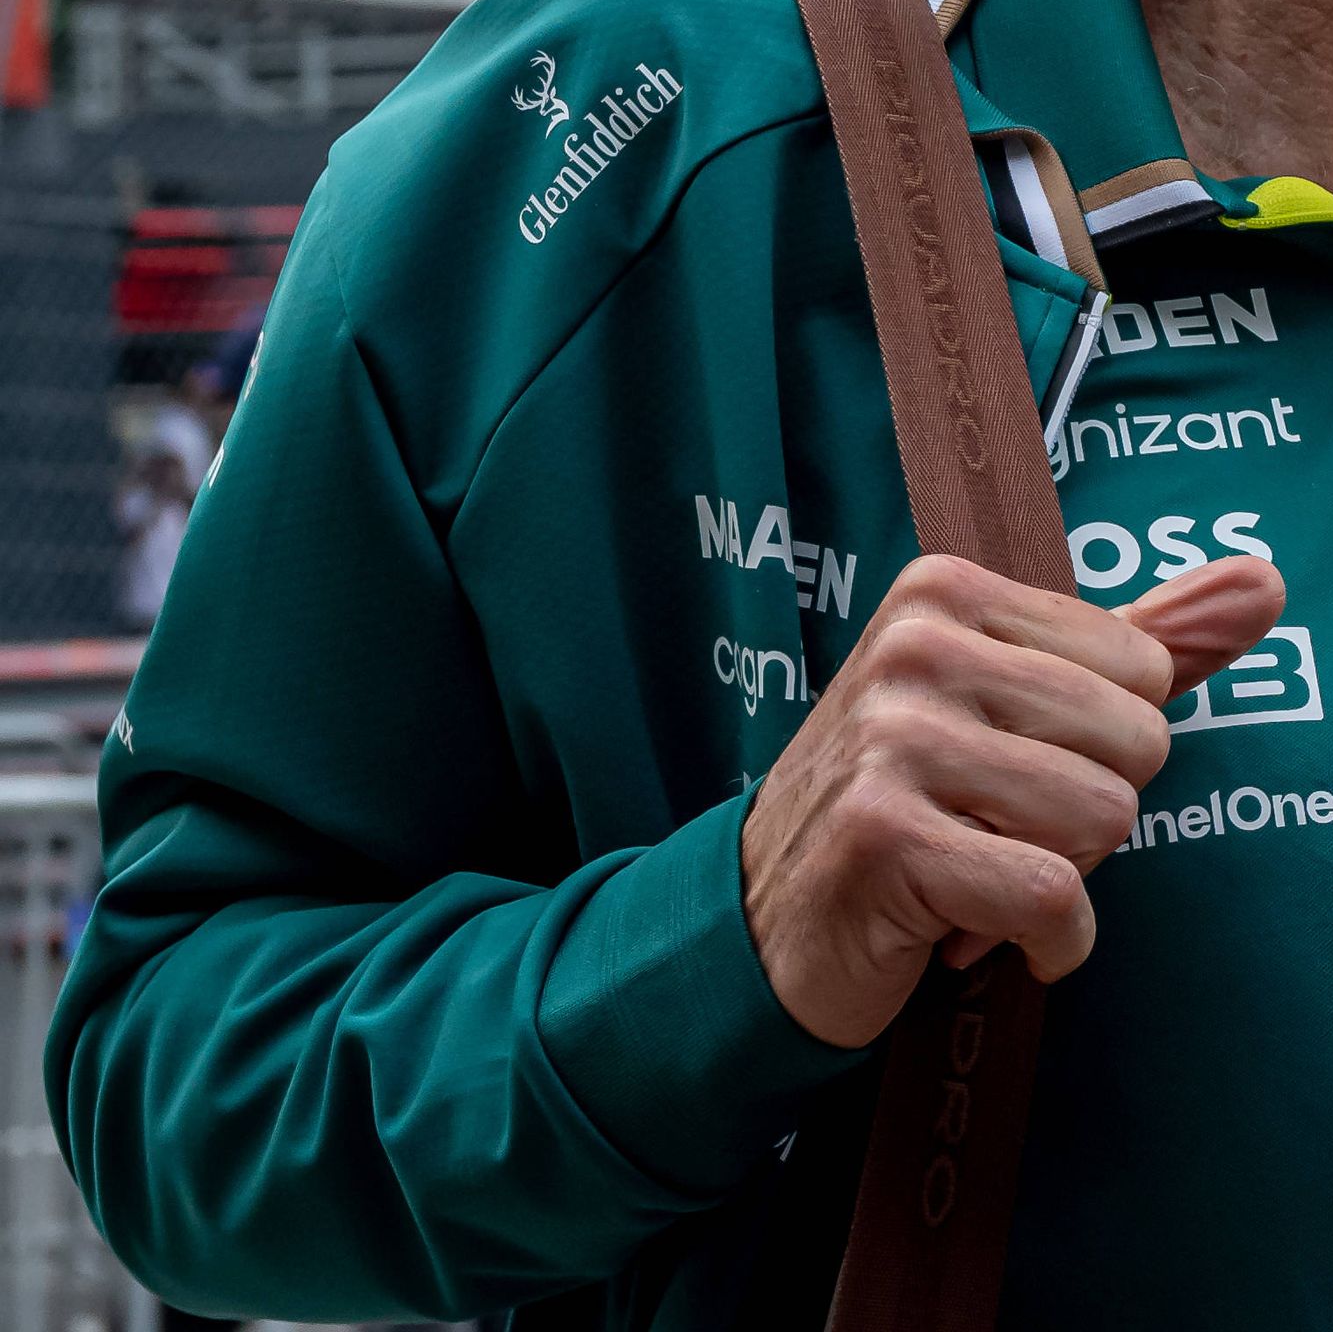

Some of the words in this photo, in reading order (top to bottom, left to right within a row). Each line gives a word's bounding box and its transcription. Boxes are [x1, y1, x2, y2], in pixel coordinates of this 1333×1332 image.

[518, 62, 684, 245] Glenfiddich
[1091, 287, 1279, 359] DEN
[695, 494, 857, 620] MAAEN
[1066, 511, 1273, 589] OSS
[713, 635, 820, 717] cogni
